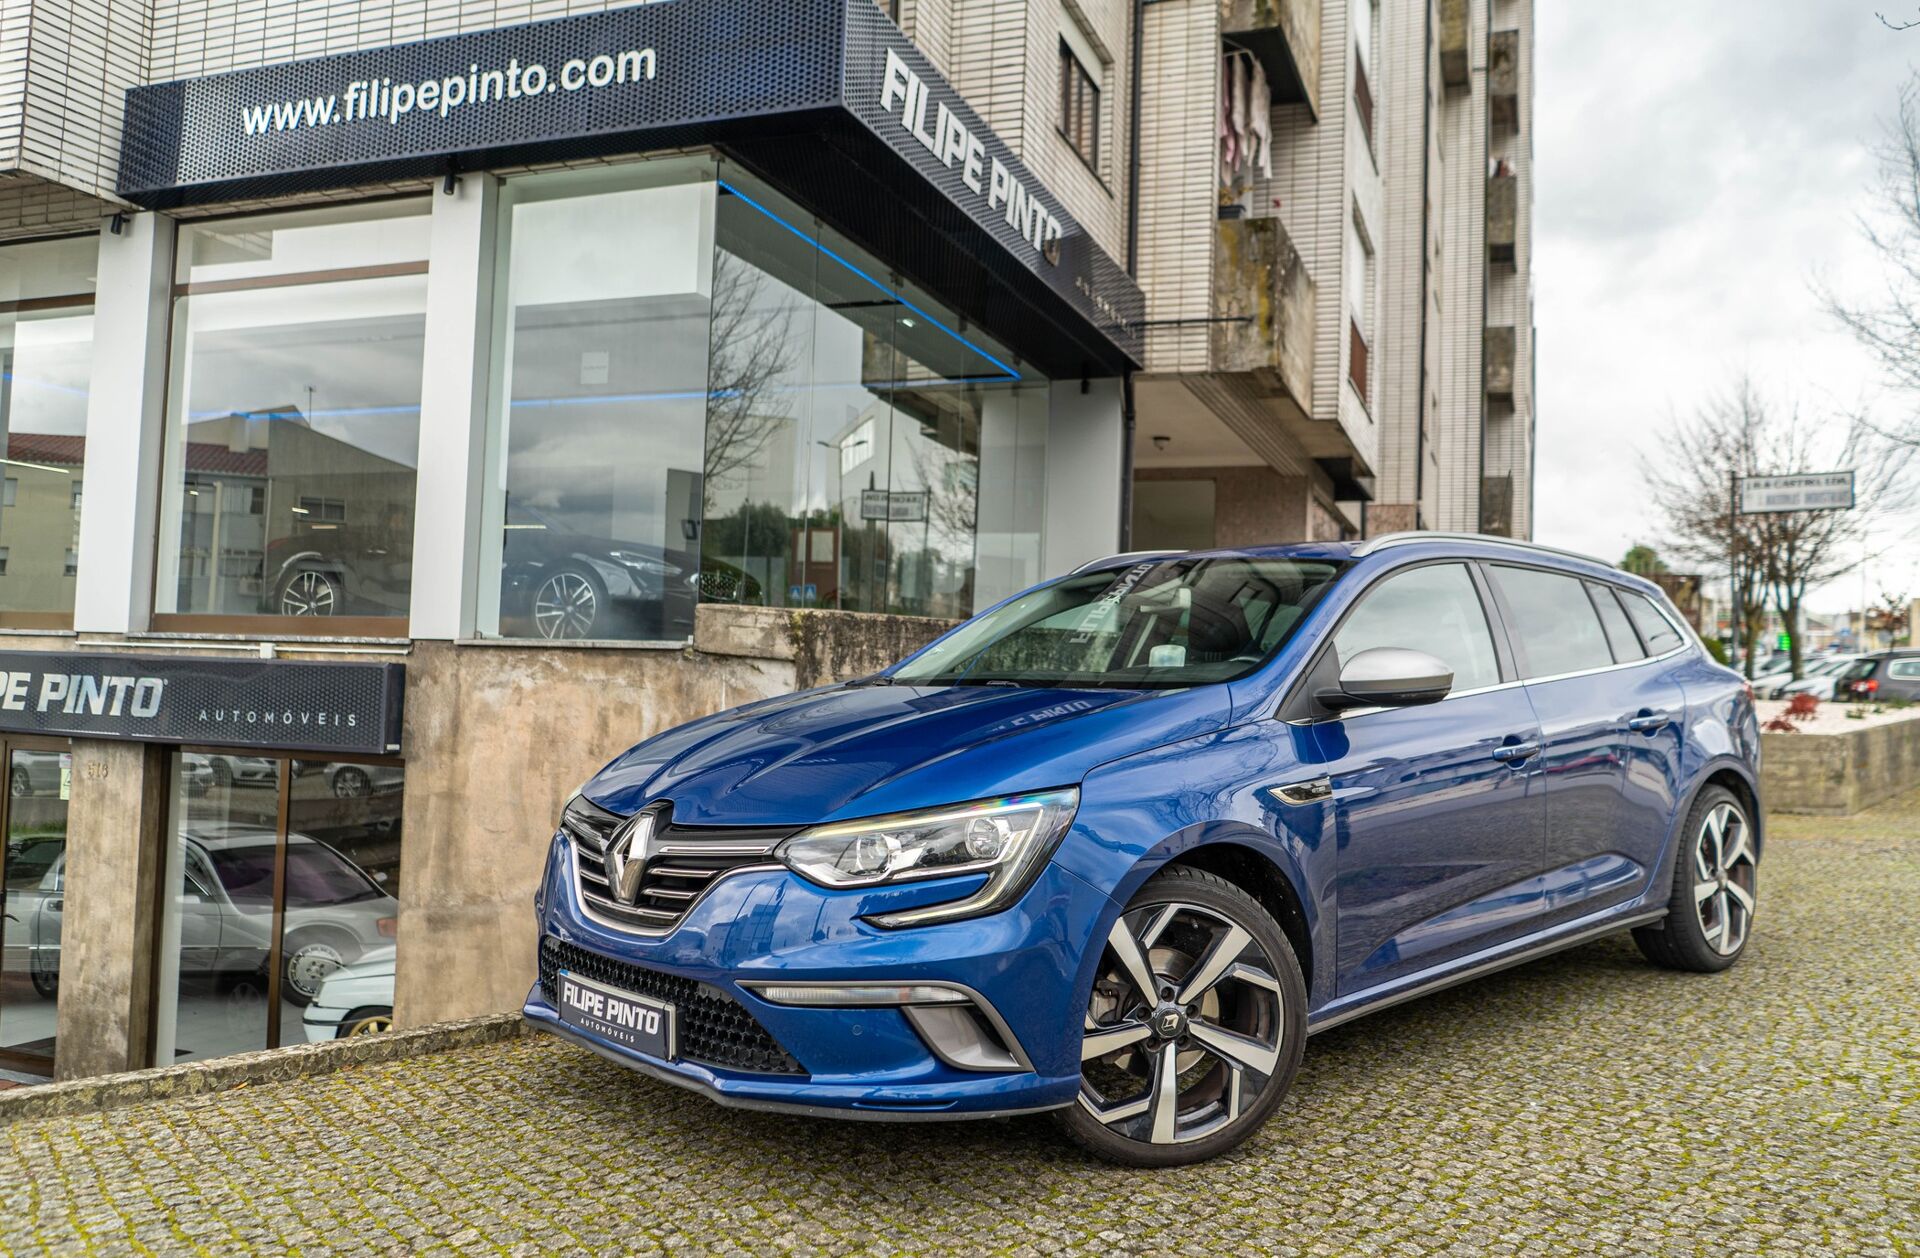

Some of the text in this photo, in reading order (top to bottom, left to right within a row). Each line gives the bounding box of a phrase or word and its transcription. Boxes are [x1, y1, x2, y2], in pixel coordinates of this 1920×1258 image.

[242, 47, 657, 136] www.filipepinto.com
[880, 47, 1063, 267] FILIPE PINTO
[37, 673, 164, 717] PINTO
[199, 709, 356, 727] AUTOMÓVEIS
[563, 981, 660, 1035] FILIPE PINTO
[580, 1017, 635, 1043] AUTOMÓVEIS
